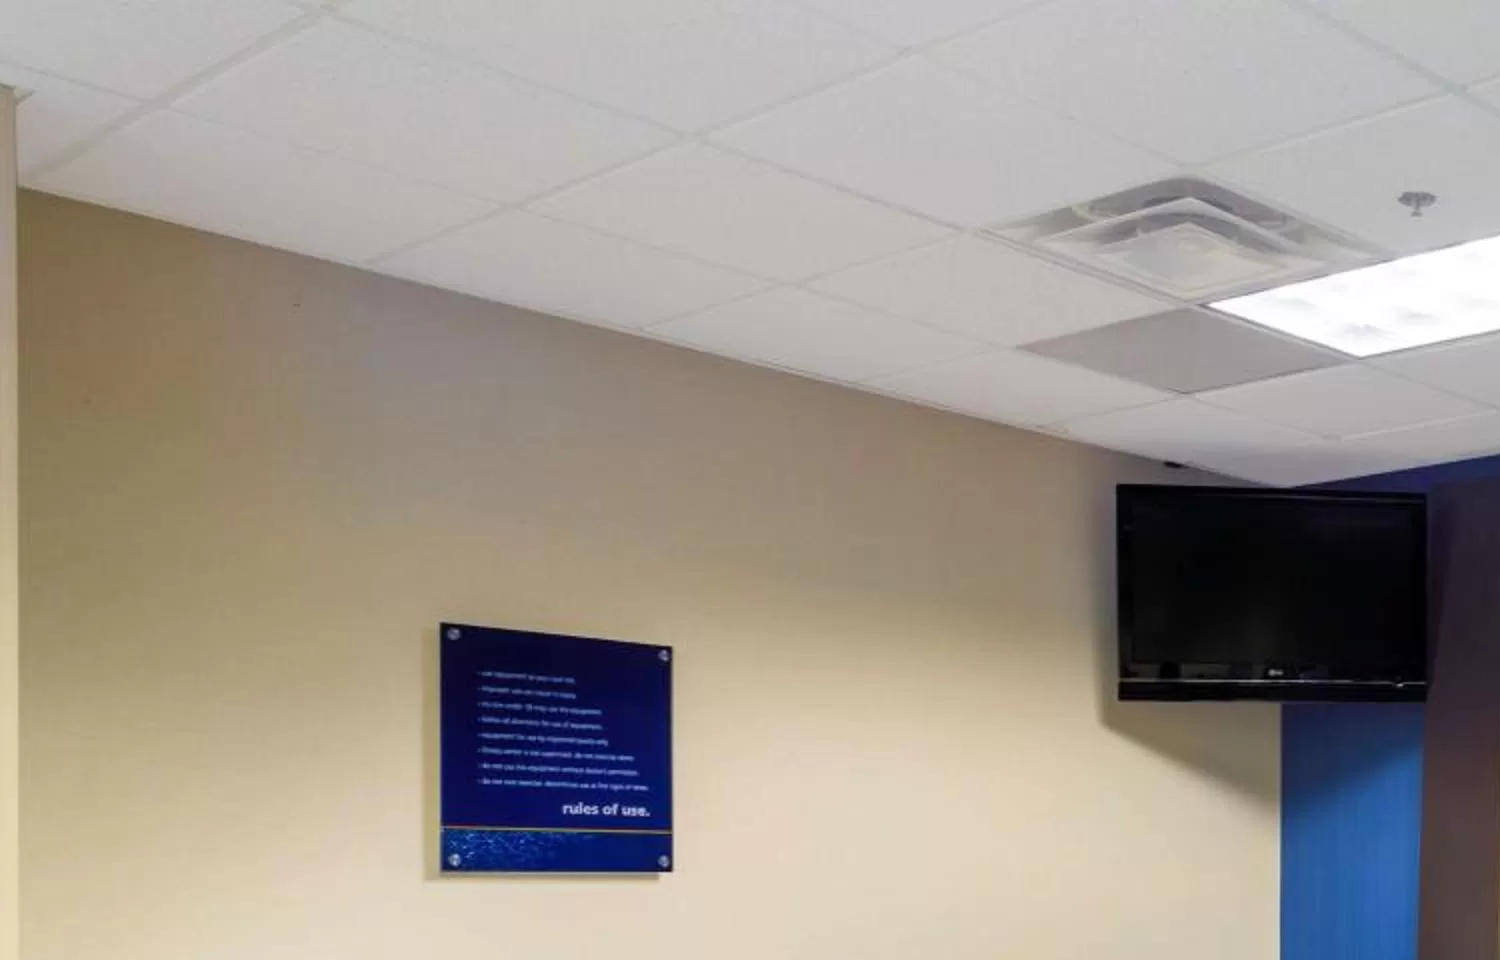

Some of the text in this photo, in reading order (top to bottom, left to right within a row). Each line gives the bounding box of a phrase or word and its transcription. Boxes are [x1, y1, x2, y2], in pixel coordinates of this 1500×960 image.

[563, 802, 651, 817] rules of use.
